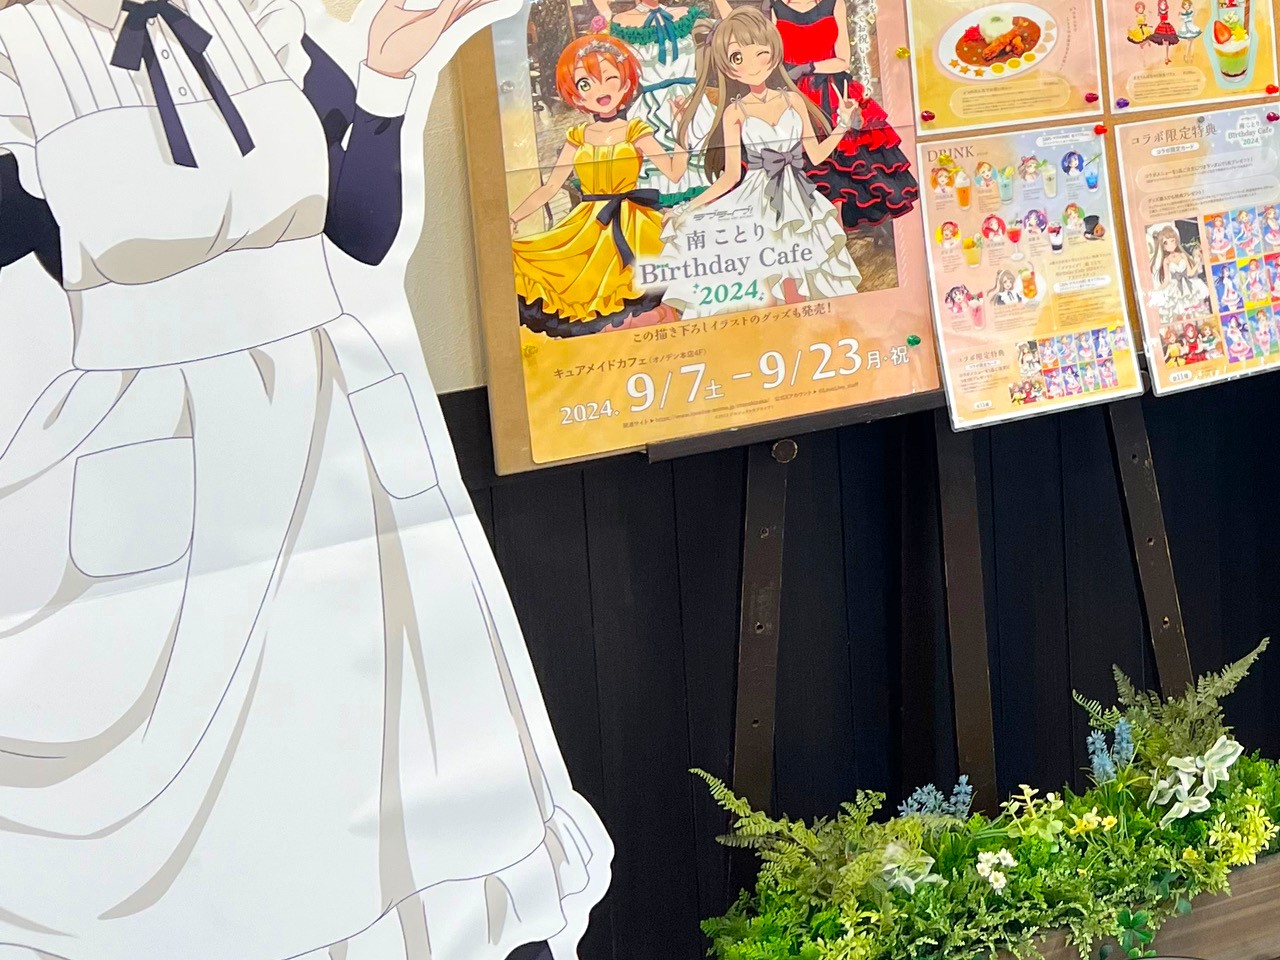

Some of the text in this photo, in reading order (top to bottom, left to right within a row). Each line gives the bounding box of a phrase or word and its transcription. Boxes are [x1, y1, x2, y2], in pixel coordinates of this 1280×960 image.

[1131, 122, 1217, 146] コラボ限定特典
[639, 242, 814, 286] Birthday Cafe
[699, 278, 759, 307] 2024
[559, 398, 621, 426] 2024.
